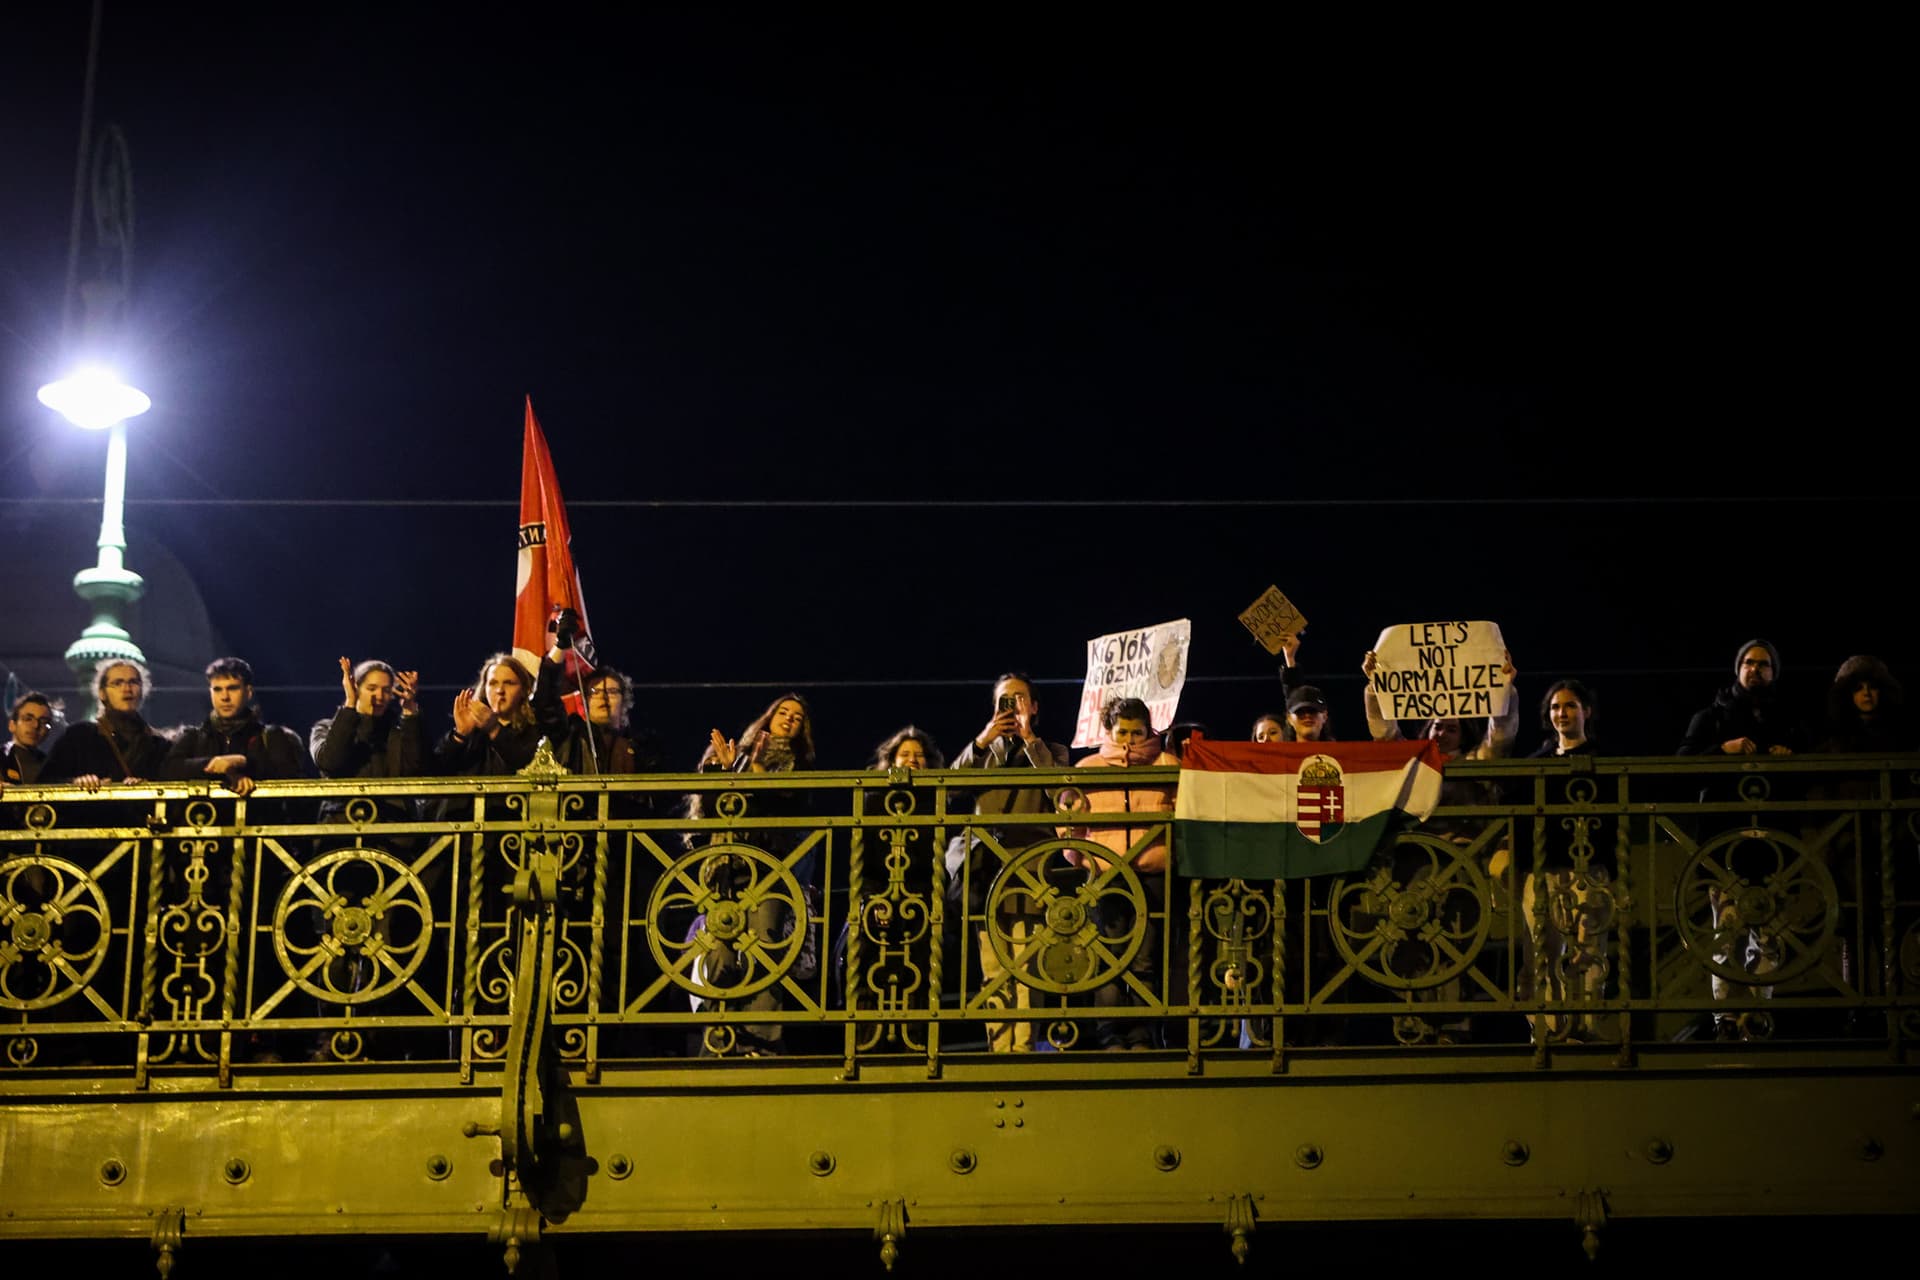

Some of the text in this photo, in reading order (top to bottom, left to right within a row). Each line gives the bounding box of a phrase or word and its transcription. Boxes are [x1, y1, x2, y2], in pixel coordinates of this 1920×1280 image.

[1410, 621, 1469, 647] LET'S
[1418, 644, 1459, 670] NOT
[1373, 664, 1504, 693] NORMALIZE
[1393, 690, 1492, 718] FASCIZM
